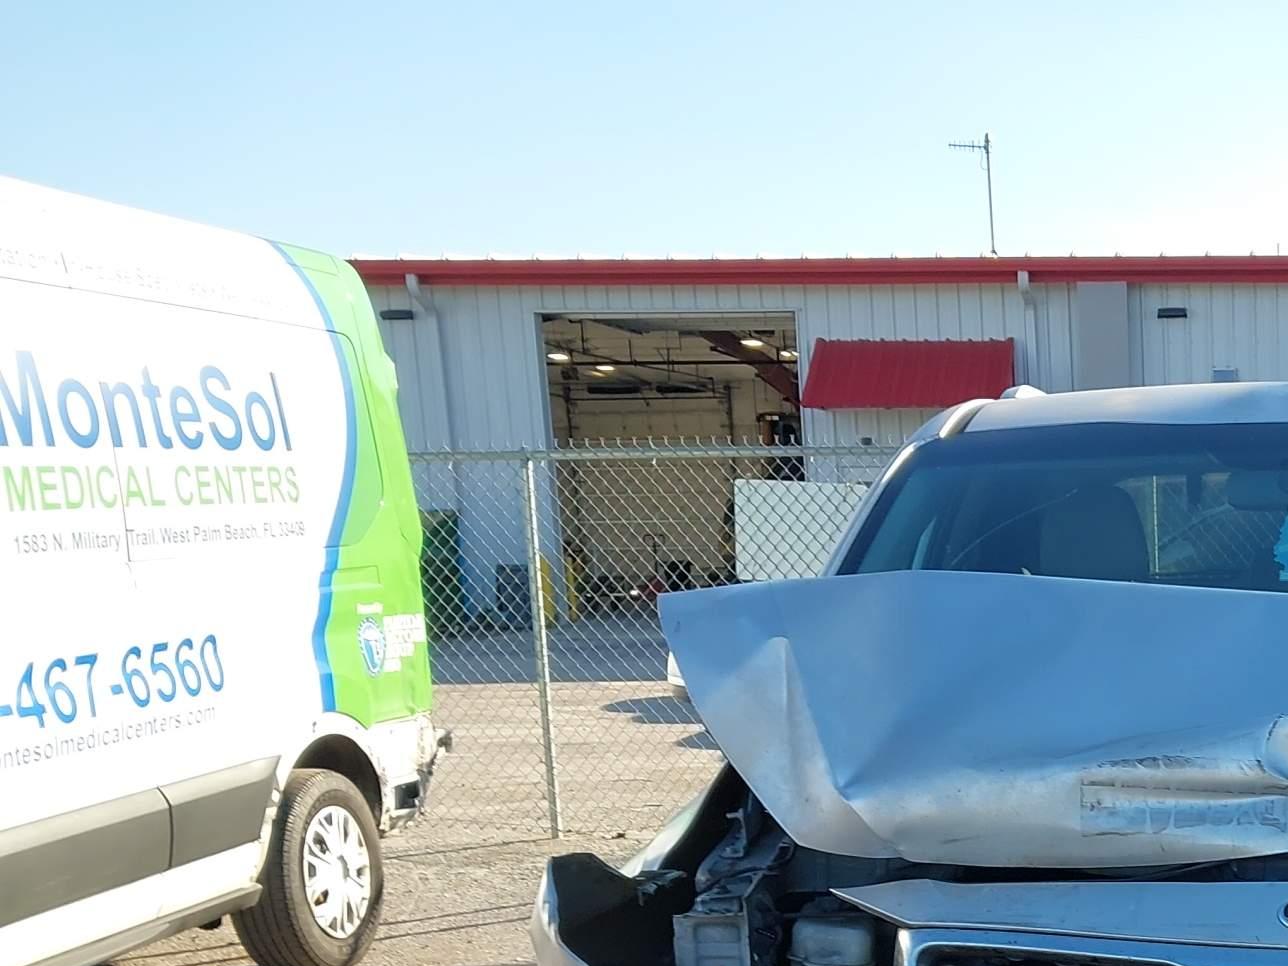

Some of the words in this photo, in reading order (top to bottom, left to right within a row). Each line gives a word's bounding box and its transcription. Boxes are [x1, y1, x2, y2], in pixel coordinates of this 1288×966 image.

[0, 350, 293, 452] MonteSol
[2, 464, 167, 513] MEDICAL
[174, 464, 301, 507] CENTERS
[14, 533, 48, 554] 1583
[72, 531, 121, 554] Military
[160, 527, 191, 544] West
[193, 525, 222, 542] Palm
[263, 522, 276, 538] FL
[0, 706, 216, 769] ntesolmedicalcenters.com
